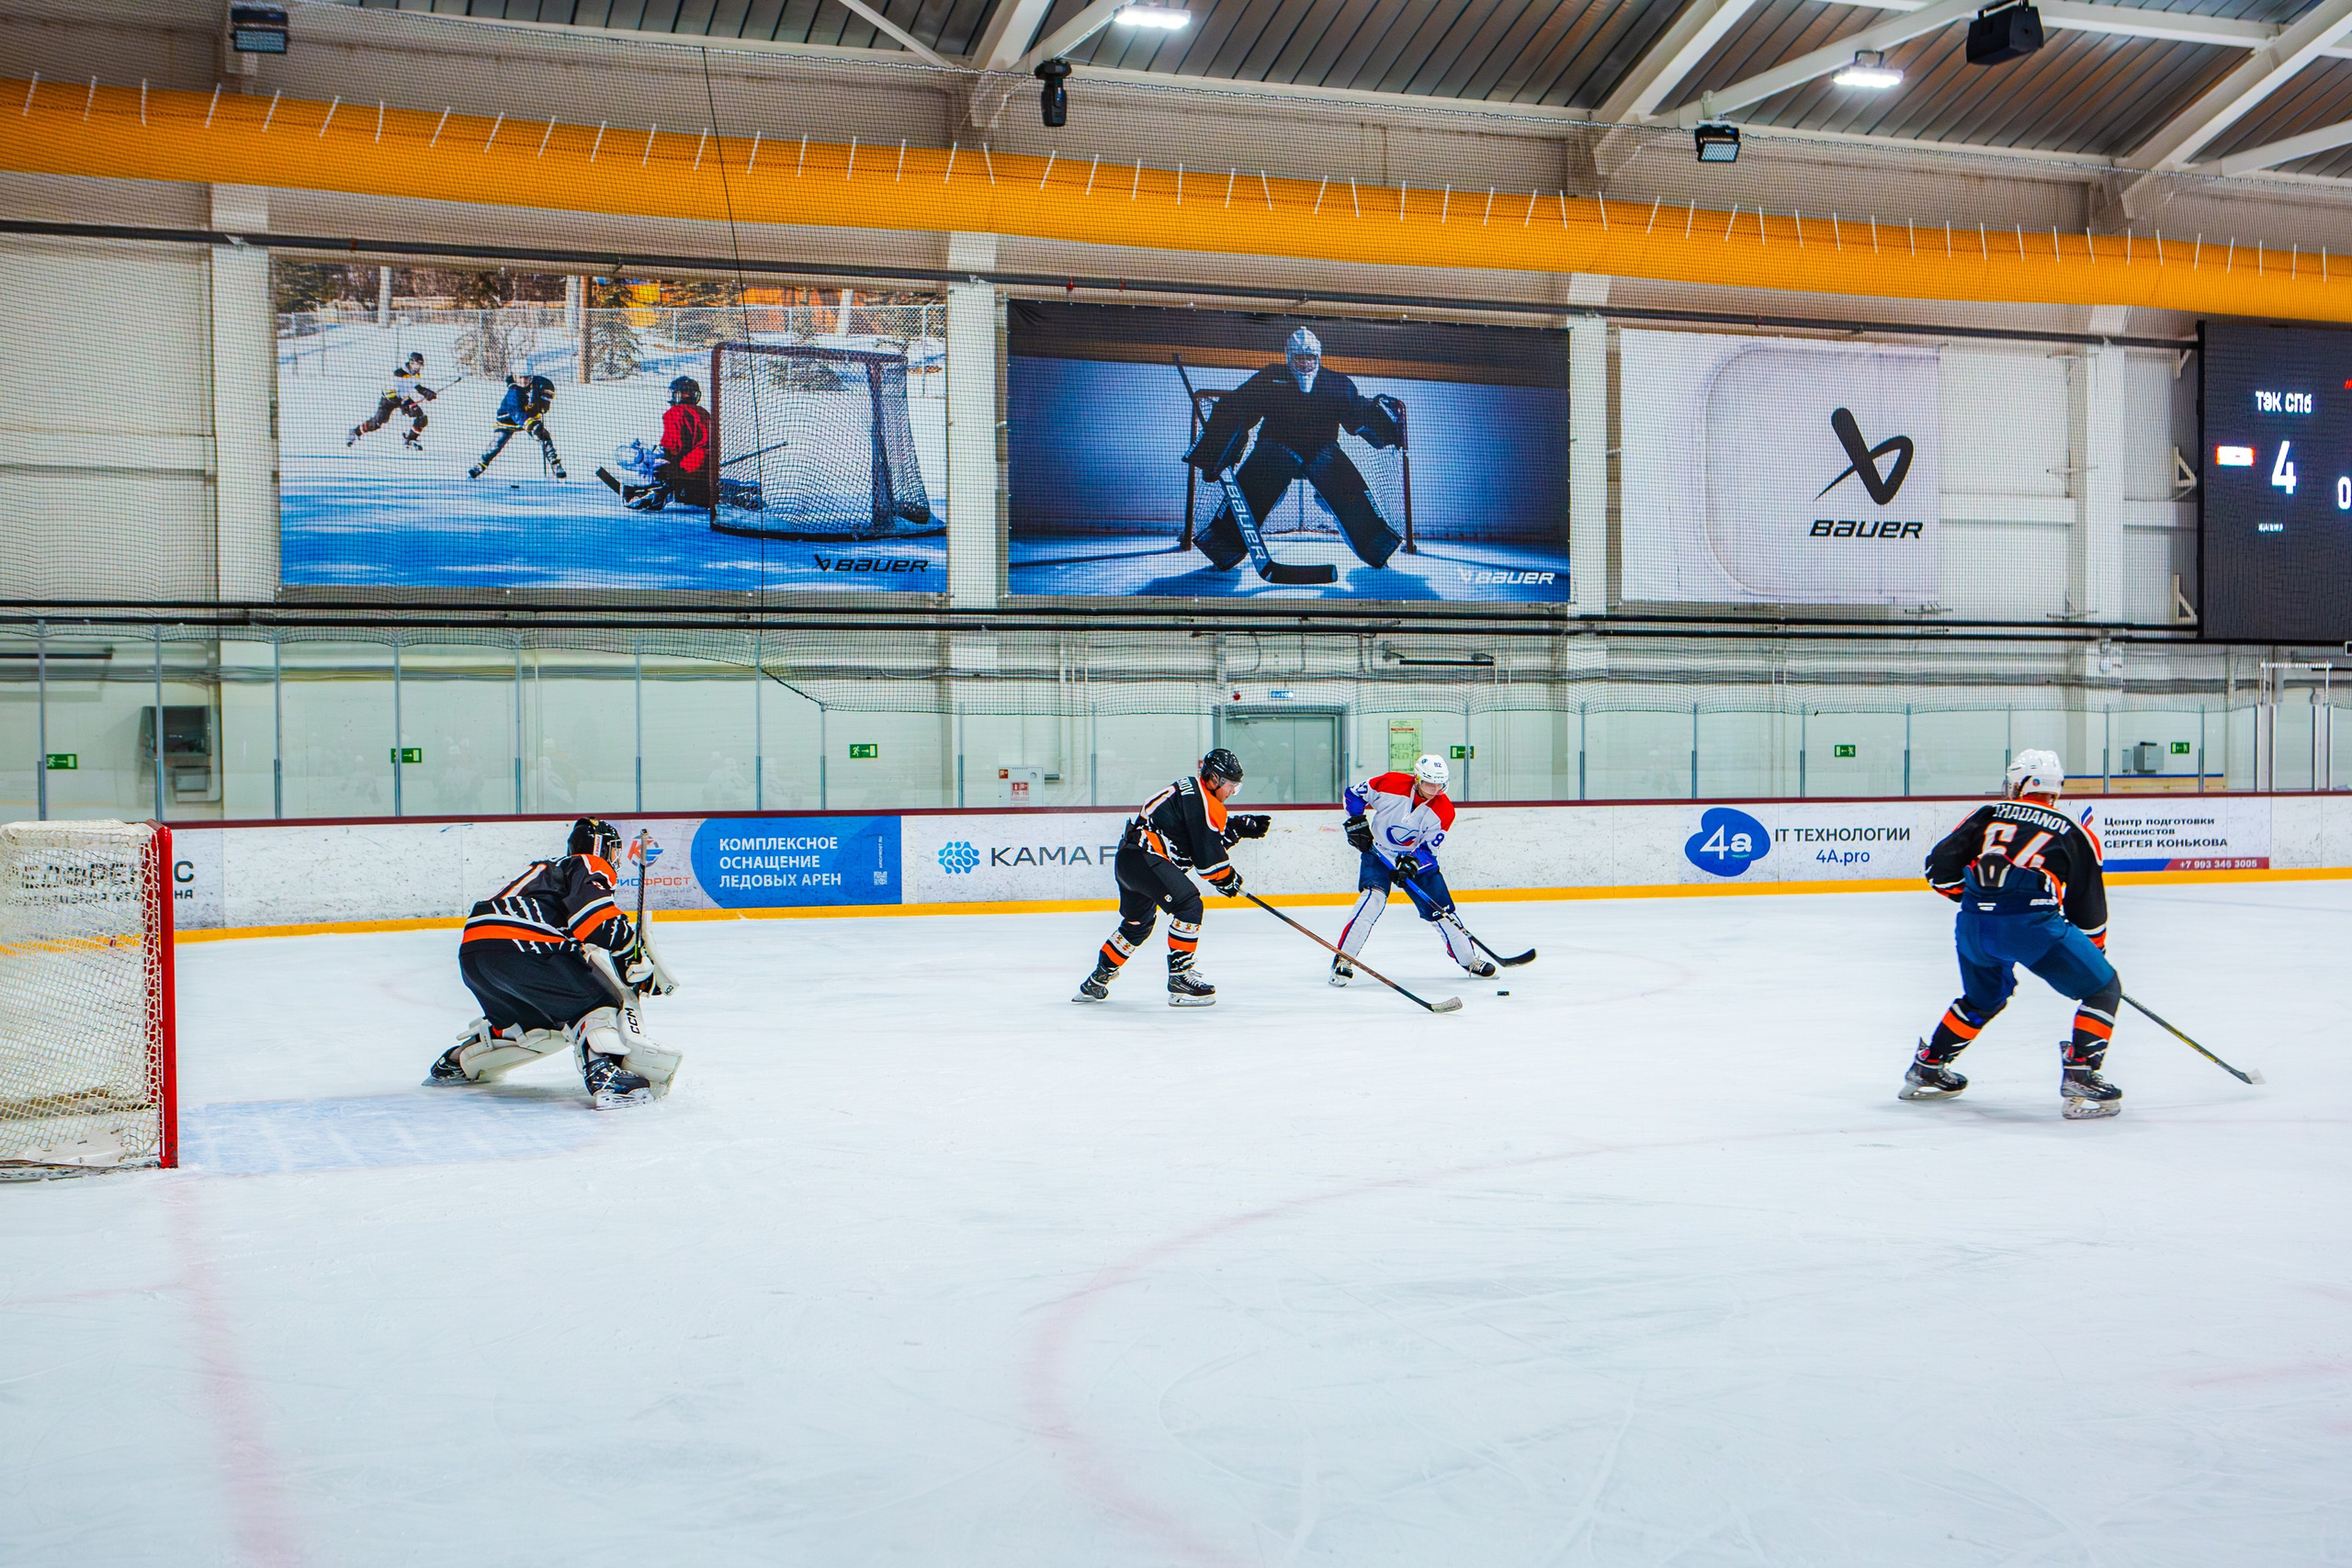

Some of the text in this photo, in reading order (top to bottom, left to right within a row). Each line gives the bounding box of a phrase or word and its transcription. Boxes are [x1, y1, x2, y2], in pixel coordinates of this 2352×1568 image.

[2255, 390, 2282, 412] ТЭК
[2271, 440, 2296, 494] 4
[2104, 818, 2215, 828] Центр подготовки
[1775, 828, 1911, 842] IT ТЕХНОЛОГИИ
[719, 836, 838, 852] КОМПЛЕКСНОЕ
[2104, 838, 2228, 849] СЕРГЕЯ КОНЬКОВА
[719, 855, 820, 871] ОСНАЩЕНИЕ
[990, 846, 1092, 867] KAMA
[1815, 849, 1871, 866] 4A.pro
[2180, 860, 2192, 869] +7
[719, 873, 842, 890] ЛЕДОВЫХ АРЕН
[625, 1007, 641, 1034] CCM
